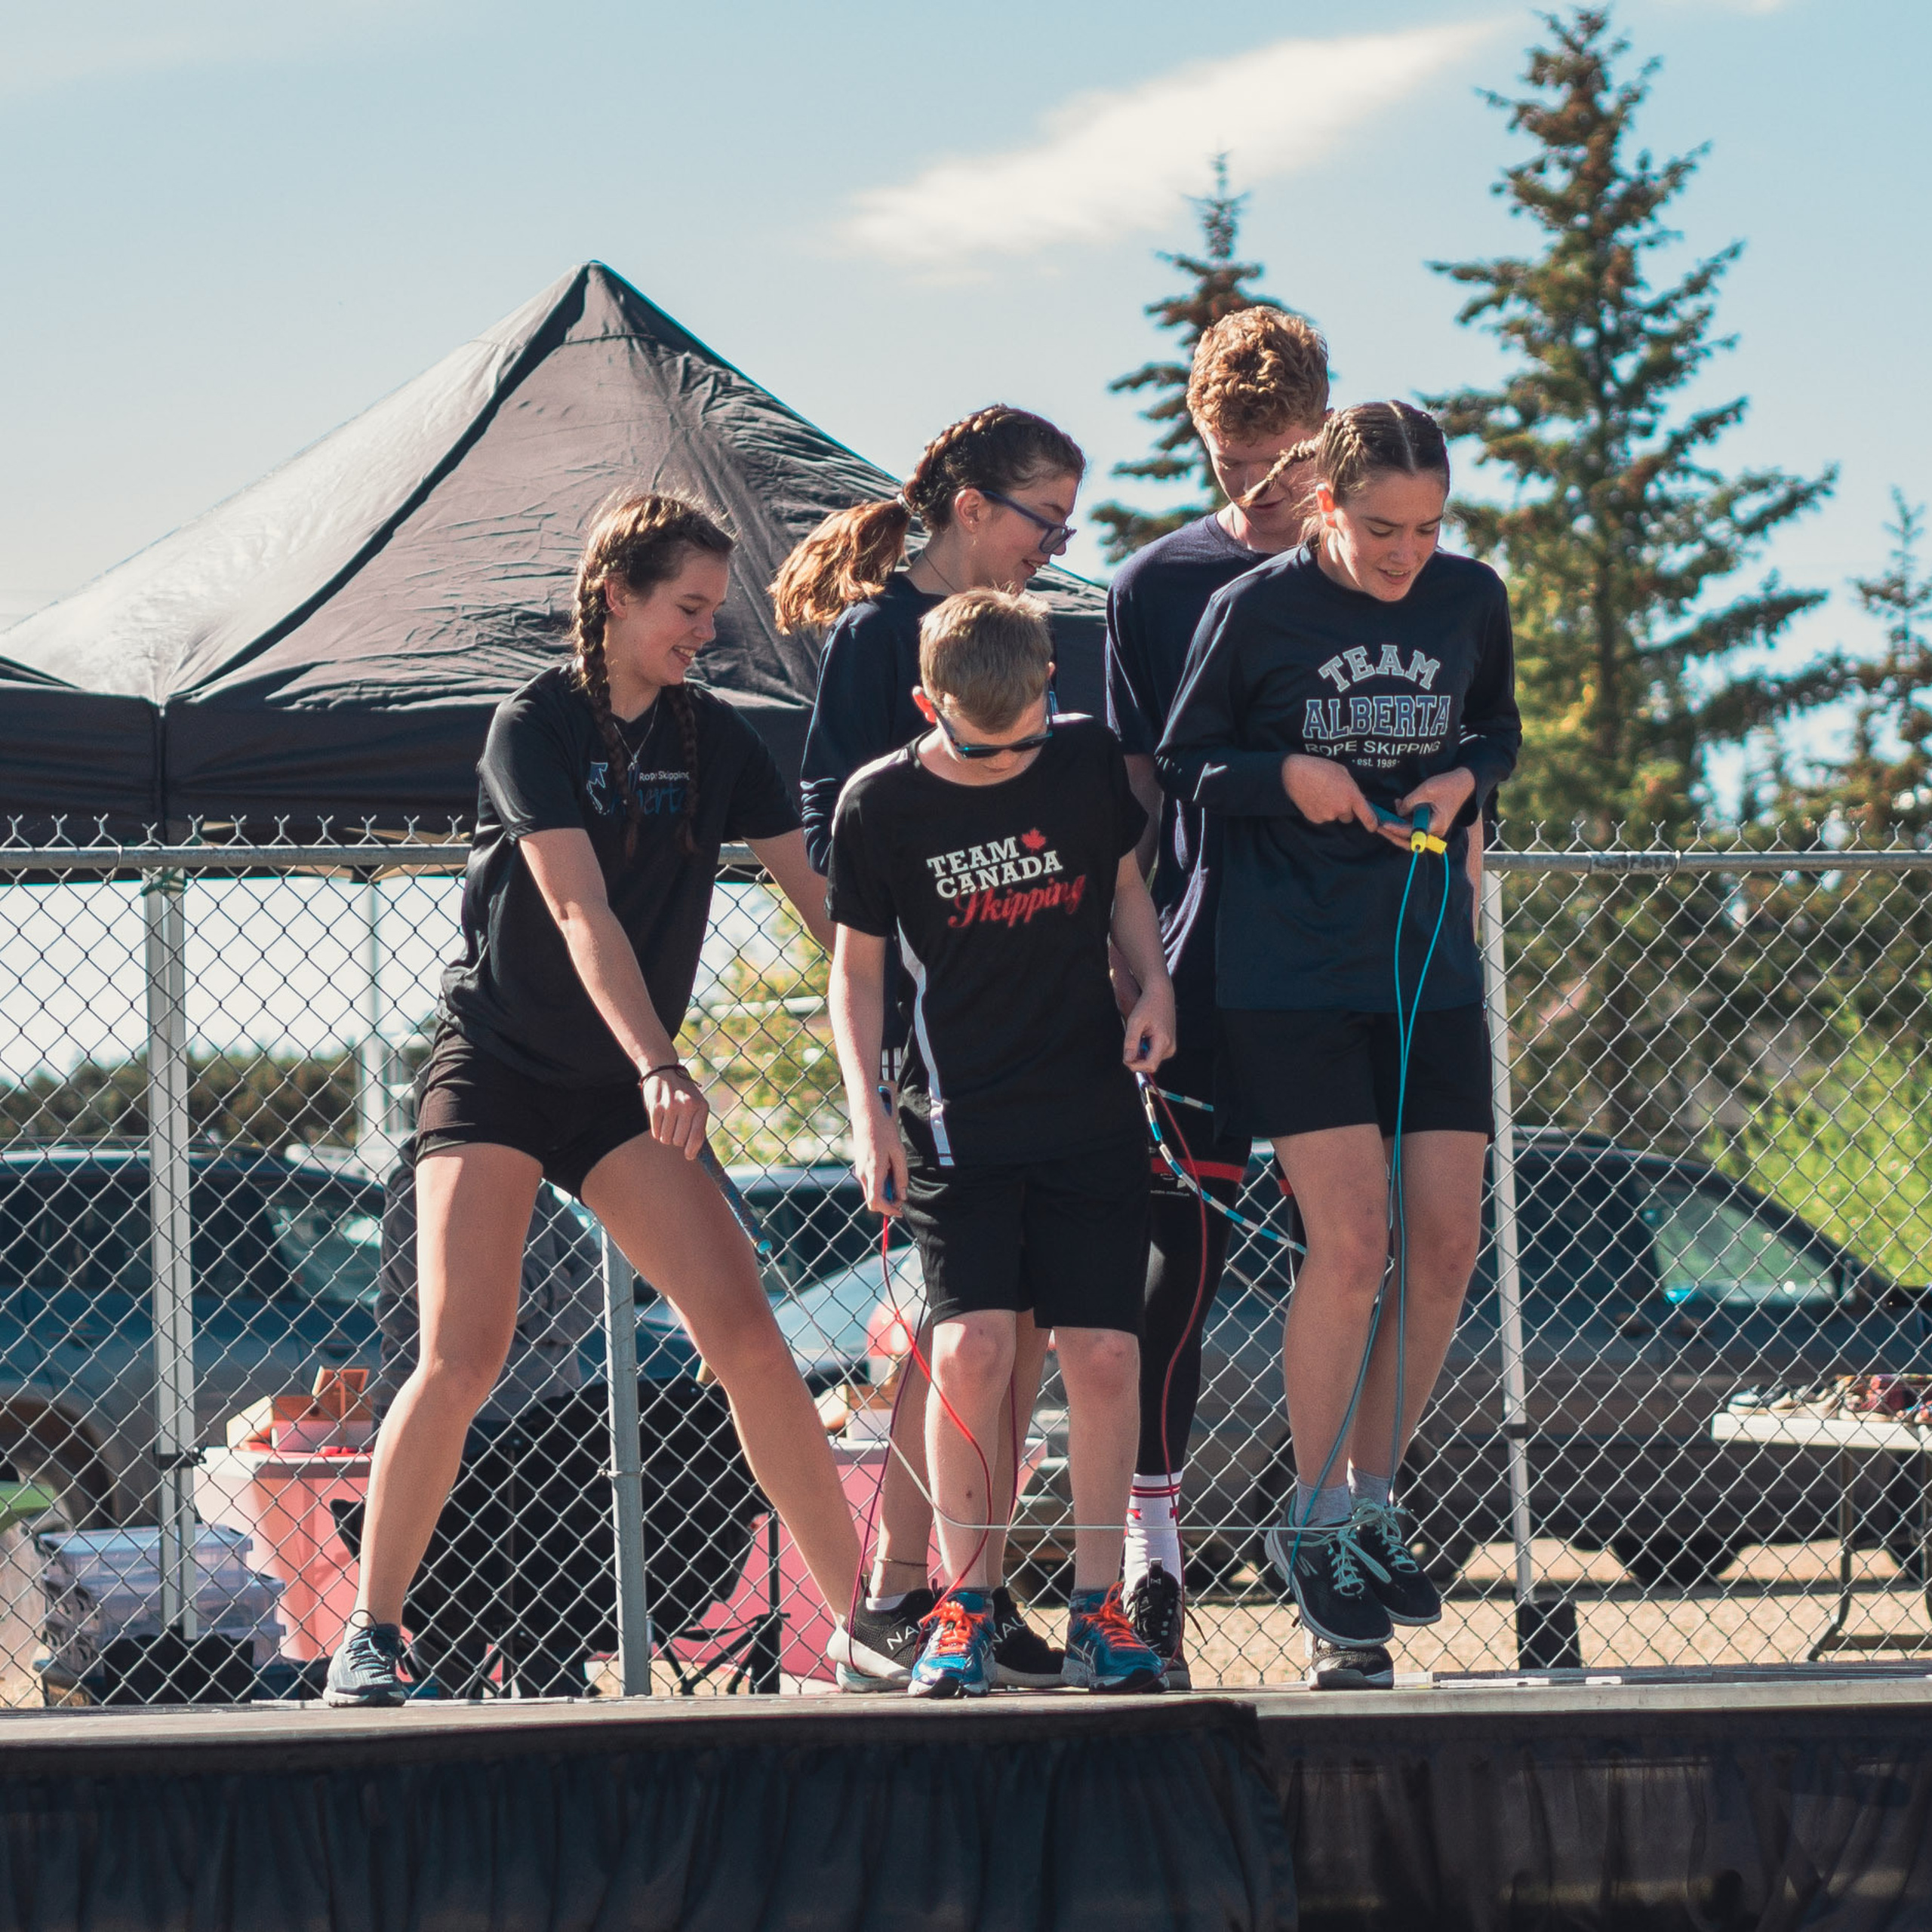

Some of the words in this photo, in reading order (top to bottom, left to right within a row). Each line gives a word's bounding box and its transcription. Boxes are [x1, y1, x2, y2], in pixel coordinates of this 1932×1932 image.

[1318, 645, 1440, 693] TEAM
[1303, 695, 1451, 740] ALBERTA
[1305, 740, 1357, 756] ROPE
[1363, 740, 1441, 755] SKIPPING
[639, 772, 657, 782] Rop
[926, 836, 1020, 878] TEAM
[936, 851, 1063, 899] CANADA
[948, 875, 1086, 928] Skipping
